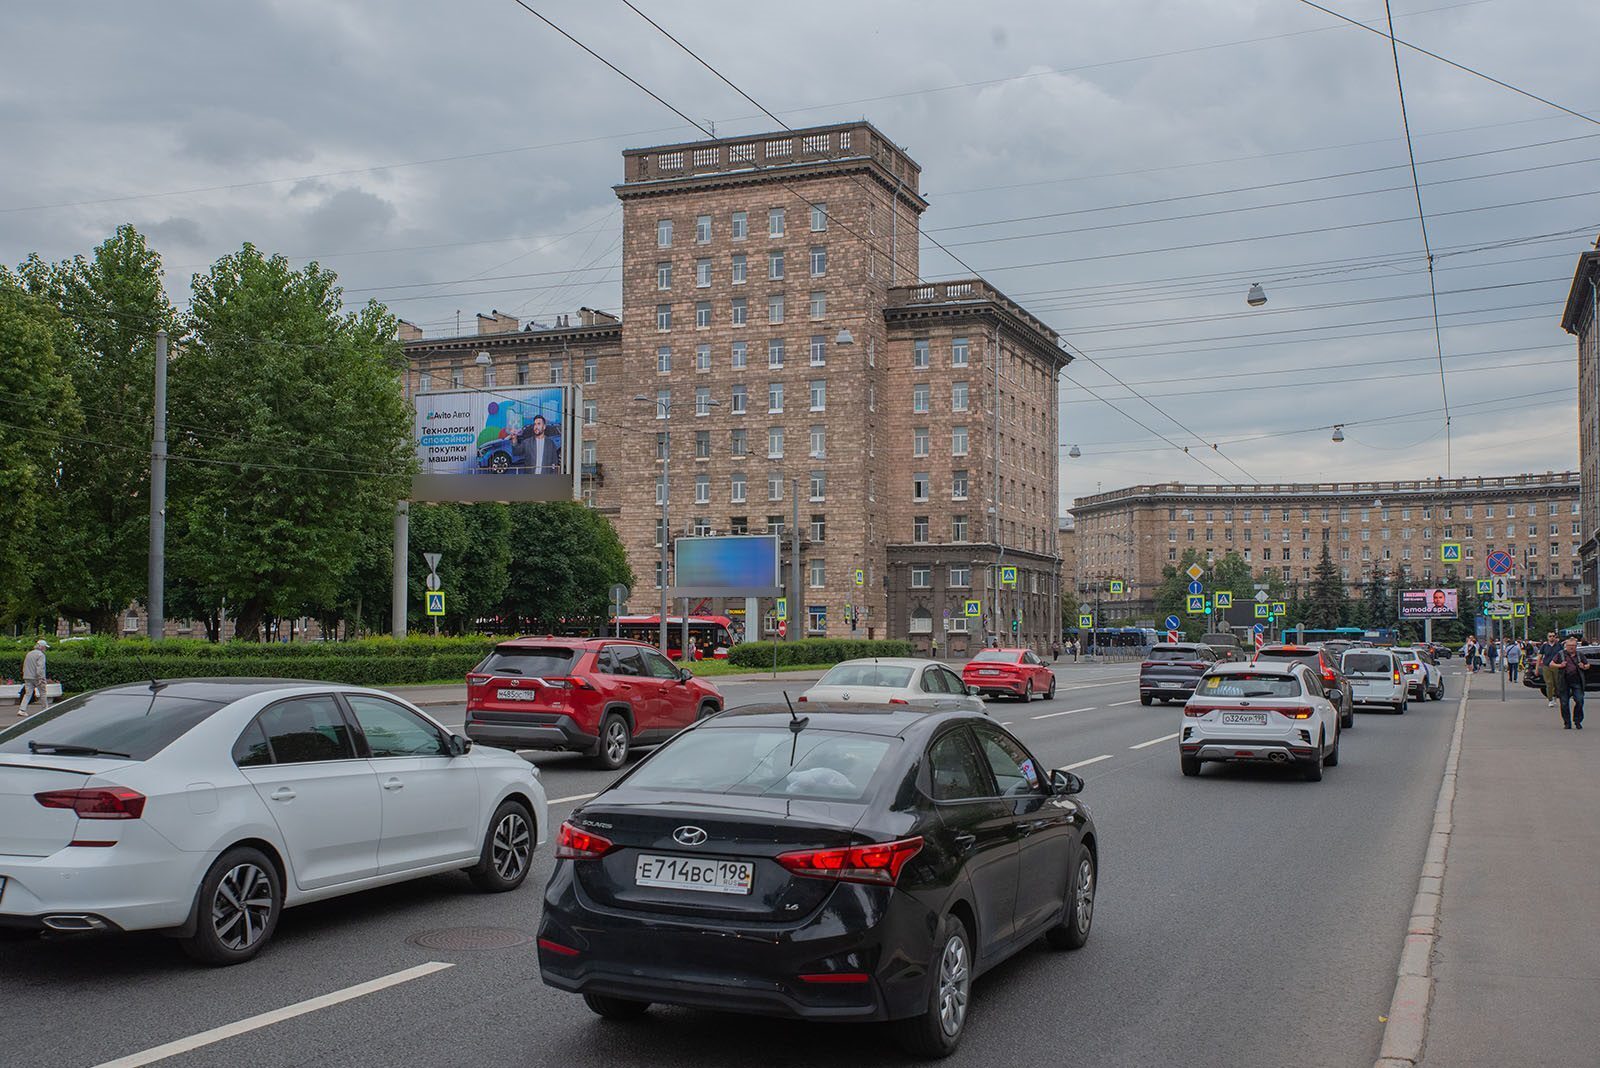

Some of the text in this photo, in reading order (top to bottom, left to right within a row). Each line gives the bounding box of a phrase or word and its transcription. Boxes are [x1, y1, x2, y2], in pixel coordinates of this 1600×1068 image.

[434, 411, 471, 419] Avito Авто
[421, 426, 475, 434] Технологии
[422, 434, 473, 444] спокойной
[428, 446, 467, 454] покупки
[428, 455, 467, 463] машины
[642, 859, 748, 883] Е714ВС 198
